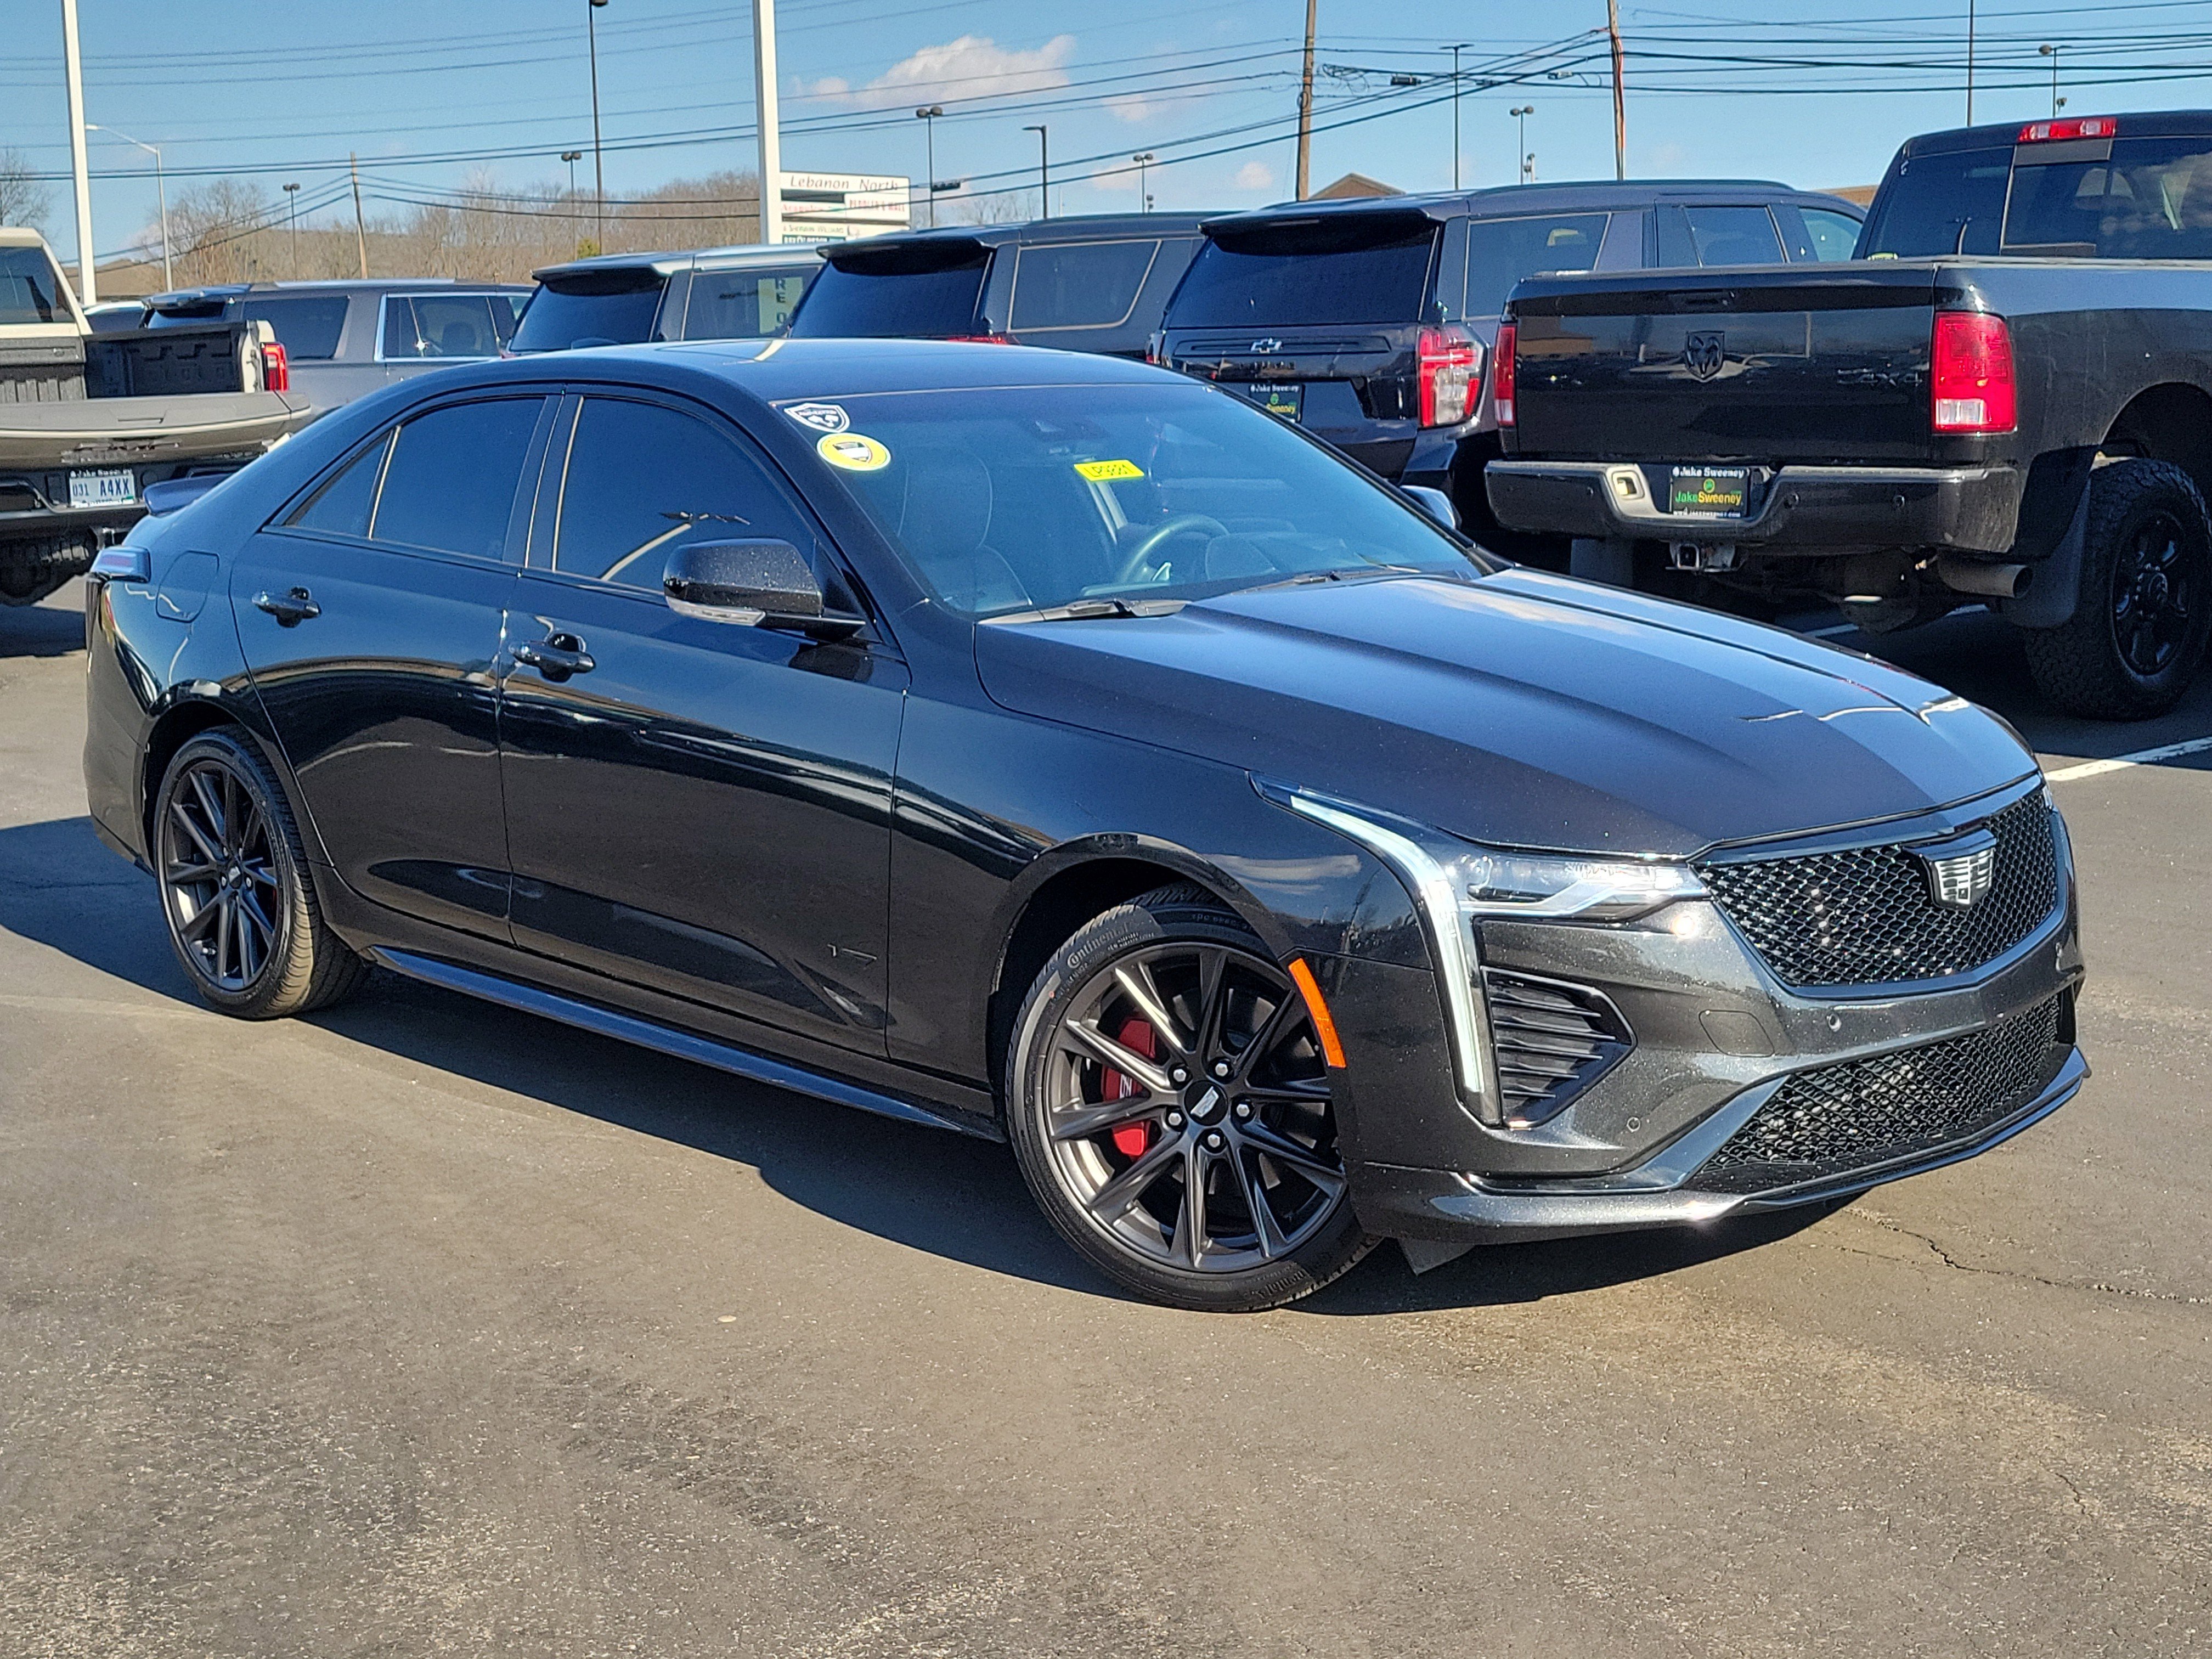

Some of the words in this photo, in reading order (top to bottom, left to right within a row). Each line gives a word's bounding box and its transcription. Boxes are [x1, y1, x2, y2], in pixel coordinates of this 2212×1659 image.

[791, 175, 849, 189] Lebanon
[860, 179, 898, 191] North
[1680, 466, 1702, 477] Jake
[1703, 466, 1745, 479] Sweeney
[72, 482, 89, 496] 031
[100, 477, 130, 496] A4XX
[1067, 922, 1128, 969] Continentl
